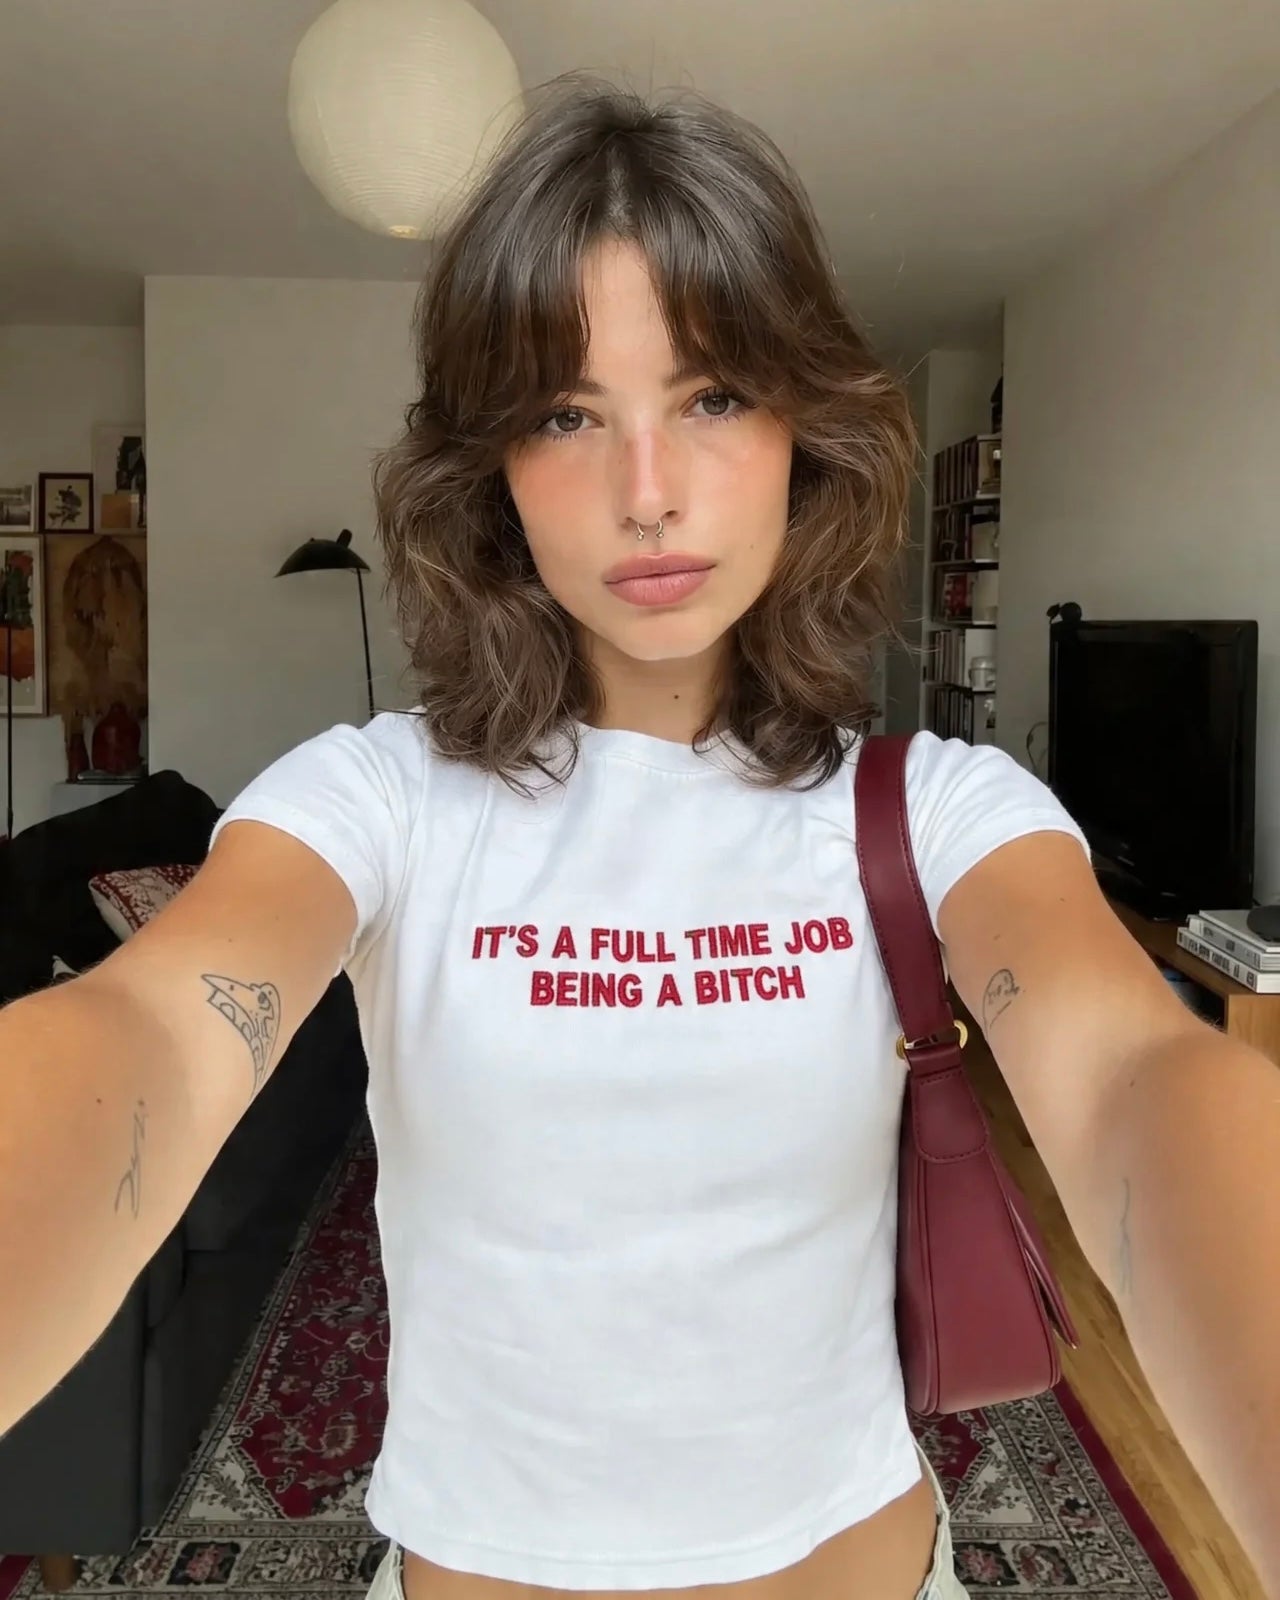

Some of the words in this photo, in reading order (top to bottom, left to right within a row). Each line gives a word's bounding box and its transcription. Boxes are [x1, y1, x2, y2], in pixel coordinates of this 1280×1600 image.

[472, 925, 539, 960] IT'S
[552, 926, 578, 959] A
[590, 928, 676, 963] FULL
[685, 923, 772, 960] TIME
[785, 916, 855, 956] JOB
[530, 971, 643, 1008] BEING
[657, 974, 683, 1008] A
[694, 965, 806, 1006] BITCH
